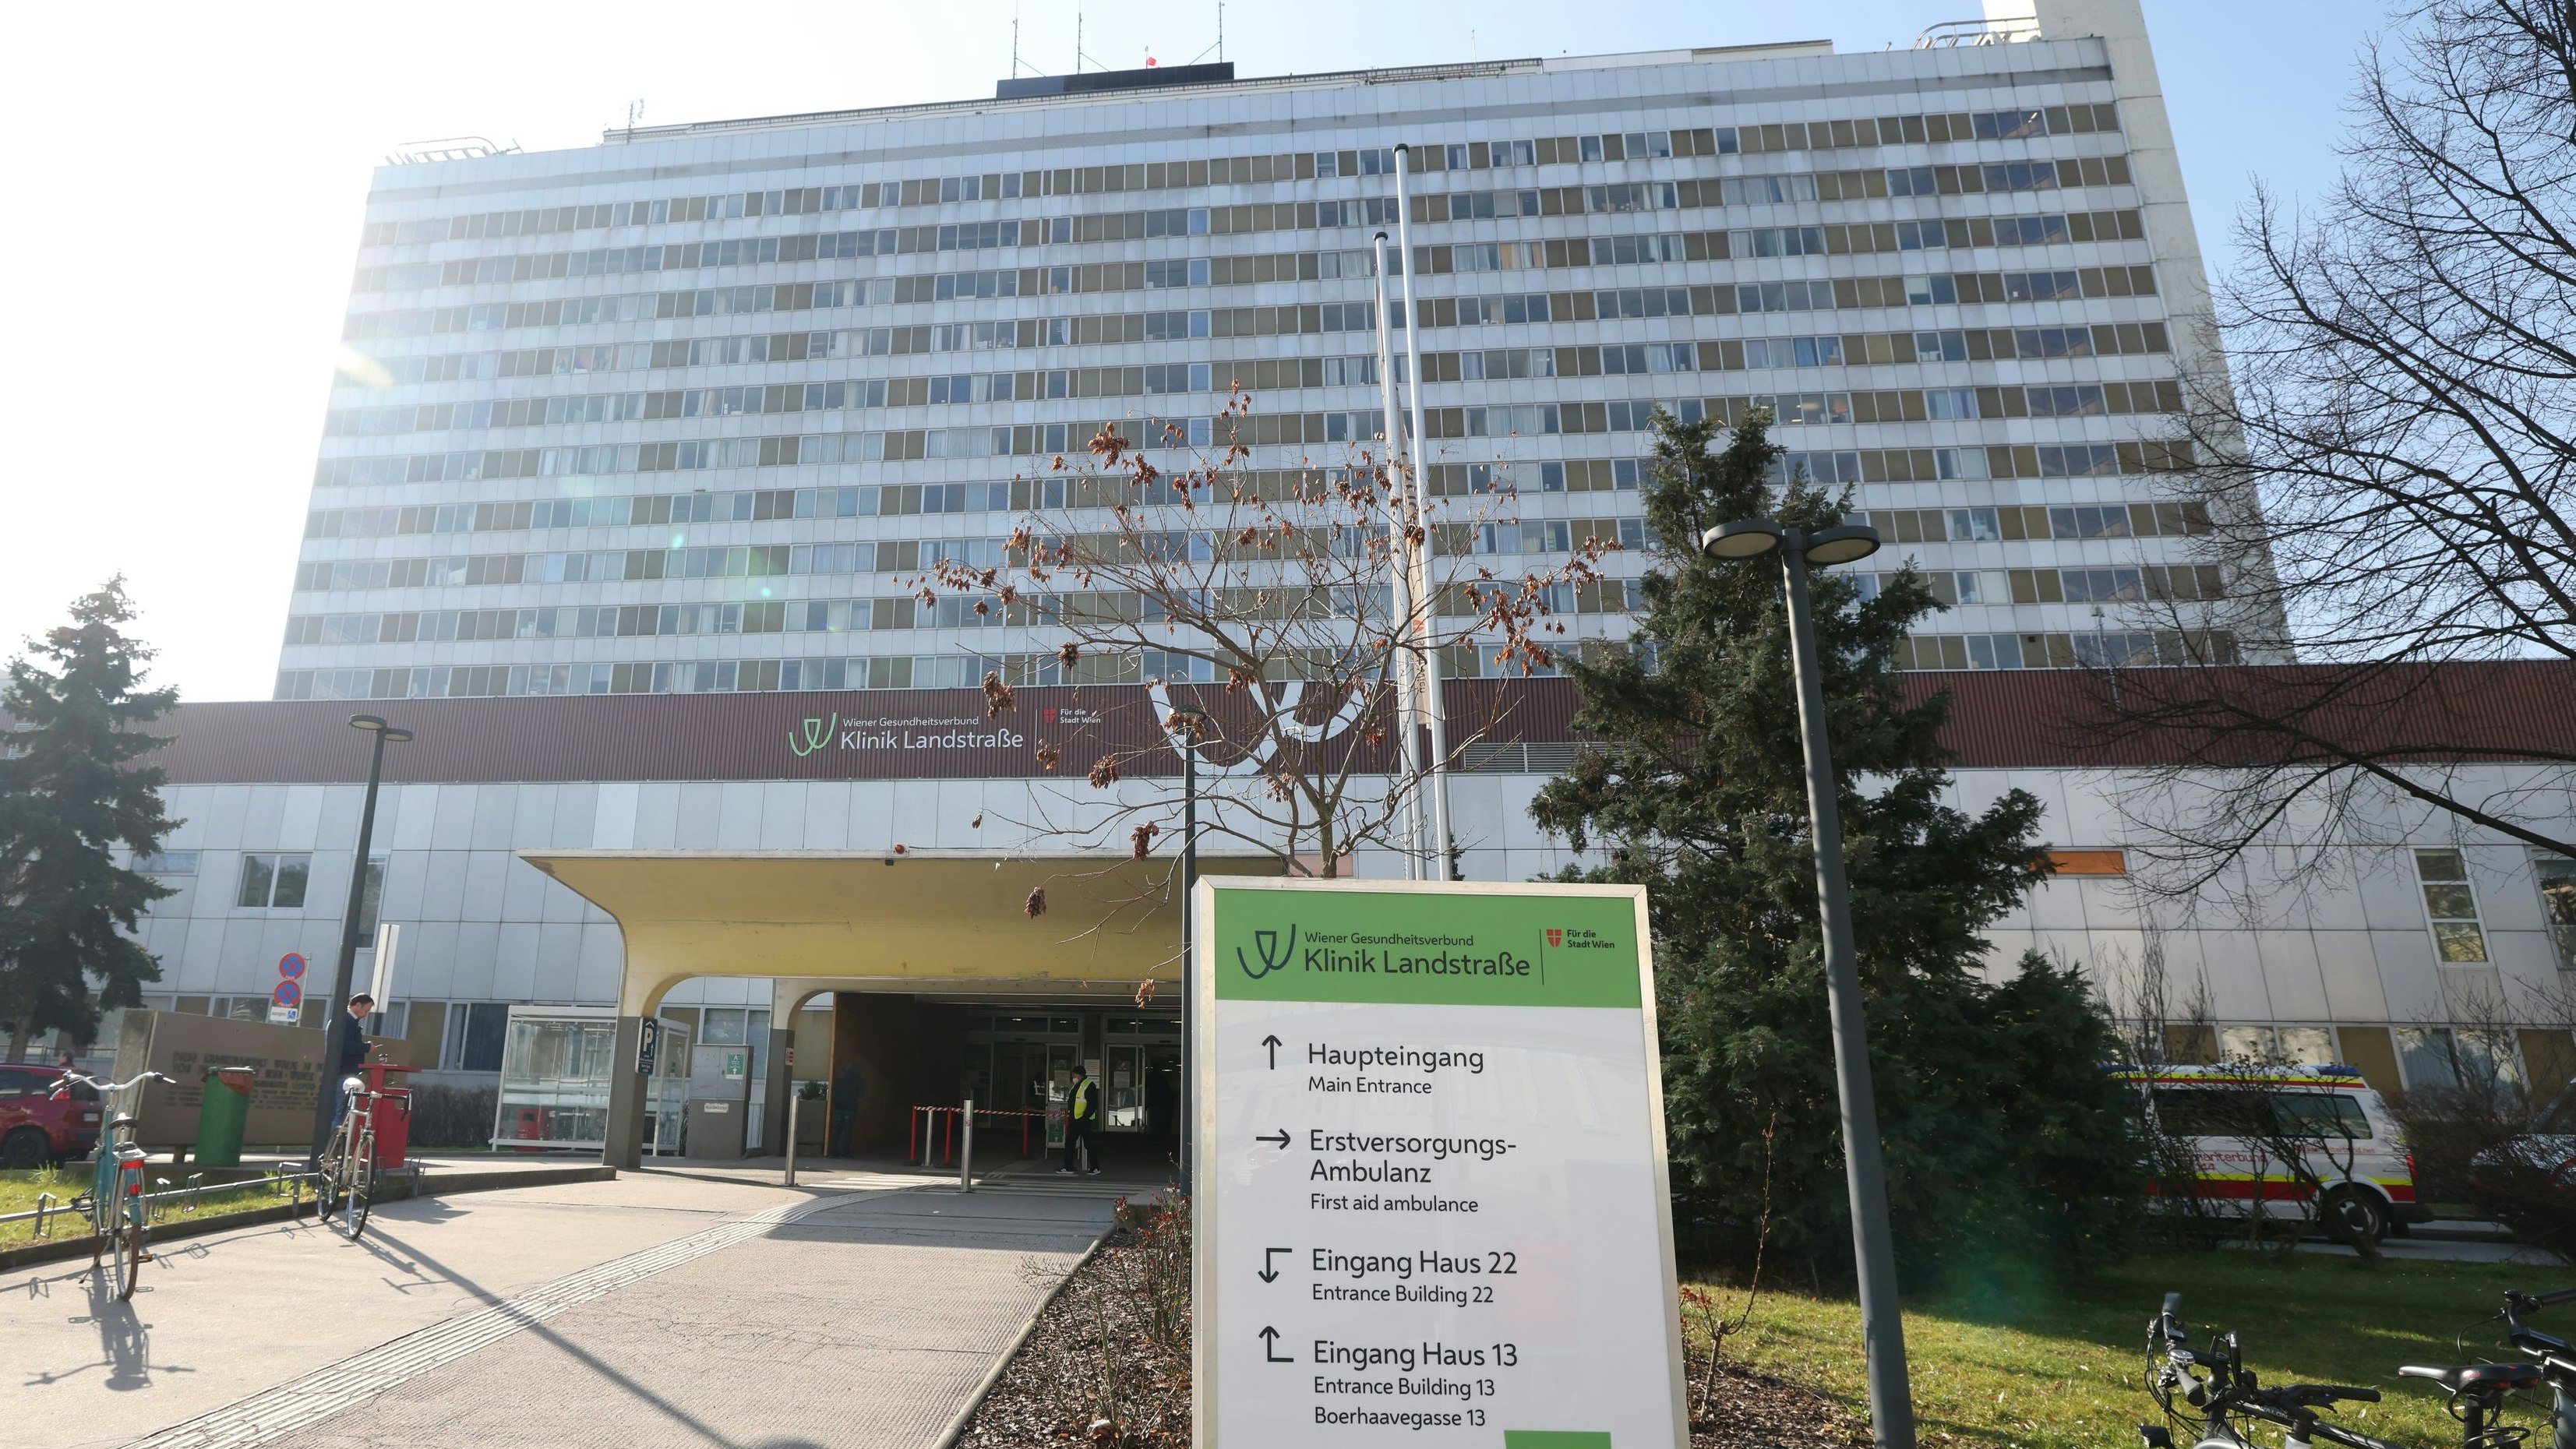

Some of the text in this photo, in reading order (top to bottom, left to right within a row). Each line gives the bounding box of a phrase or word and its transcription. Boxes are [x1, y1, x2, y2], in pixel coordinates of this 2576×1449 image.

[842, 715, 979, 727] Wiener Gesundheitsverbund
[1060, 707, 1073, 716] Für
[1081, 715, 1101, 724] Wien
[841, 728, 1024, 749] Klinik Landstraße
[1305, 931, 1473, 947] Wiener Gesundheitsverbund
[1567, 929, 1597, 938] Für die
[1567, 940, 1615, 949] Stadt Wien
[1304, 947, 1530, 976] Klinik Landstraße
[643, 1028, 654, 1052] P
[1308, 1042, 1484, 1074] Haupteingang
[1308, 1076, 1432, 1094] Main Entrance
[1311, 1129, 1516, 1159] Erstversorgungs-
[1310, 1159, 1431, 1183] Ambulanz
[1311, 1193, 1479, 1212] First aid ambulance
[1312, 1248, 1518, 1280] Eingang Haus 22
[1313, 1283, 1494, 1308] Entrance Building 22
[1314, 1340, 1518, 1373] Eingang Haus 13
[1314, 1376, 1495, 1401] Entrance Building 13
[1314, 1406, 1486, 1431] Boerhaavegasse 13
